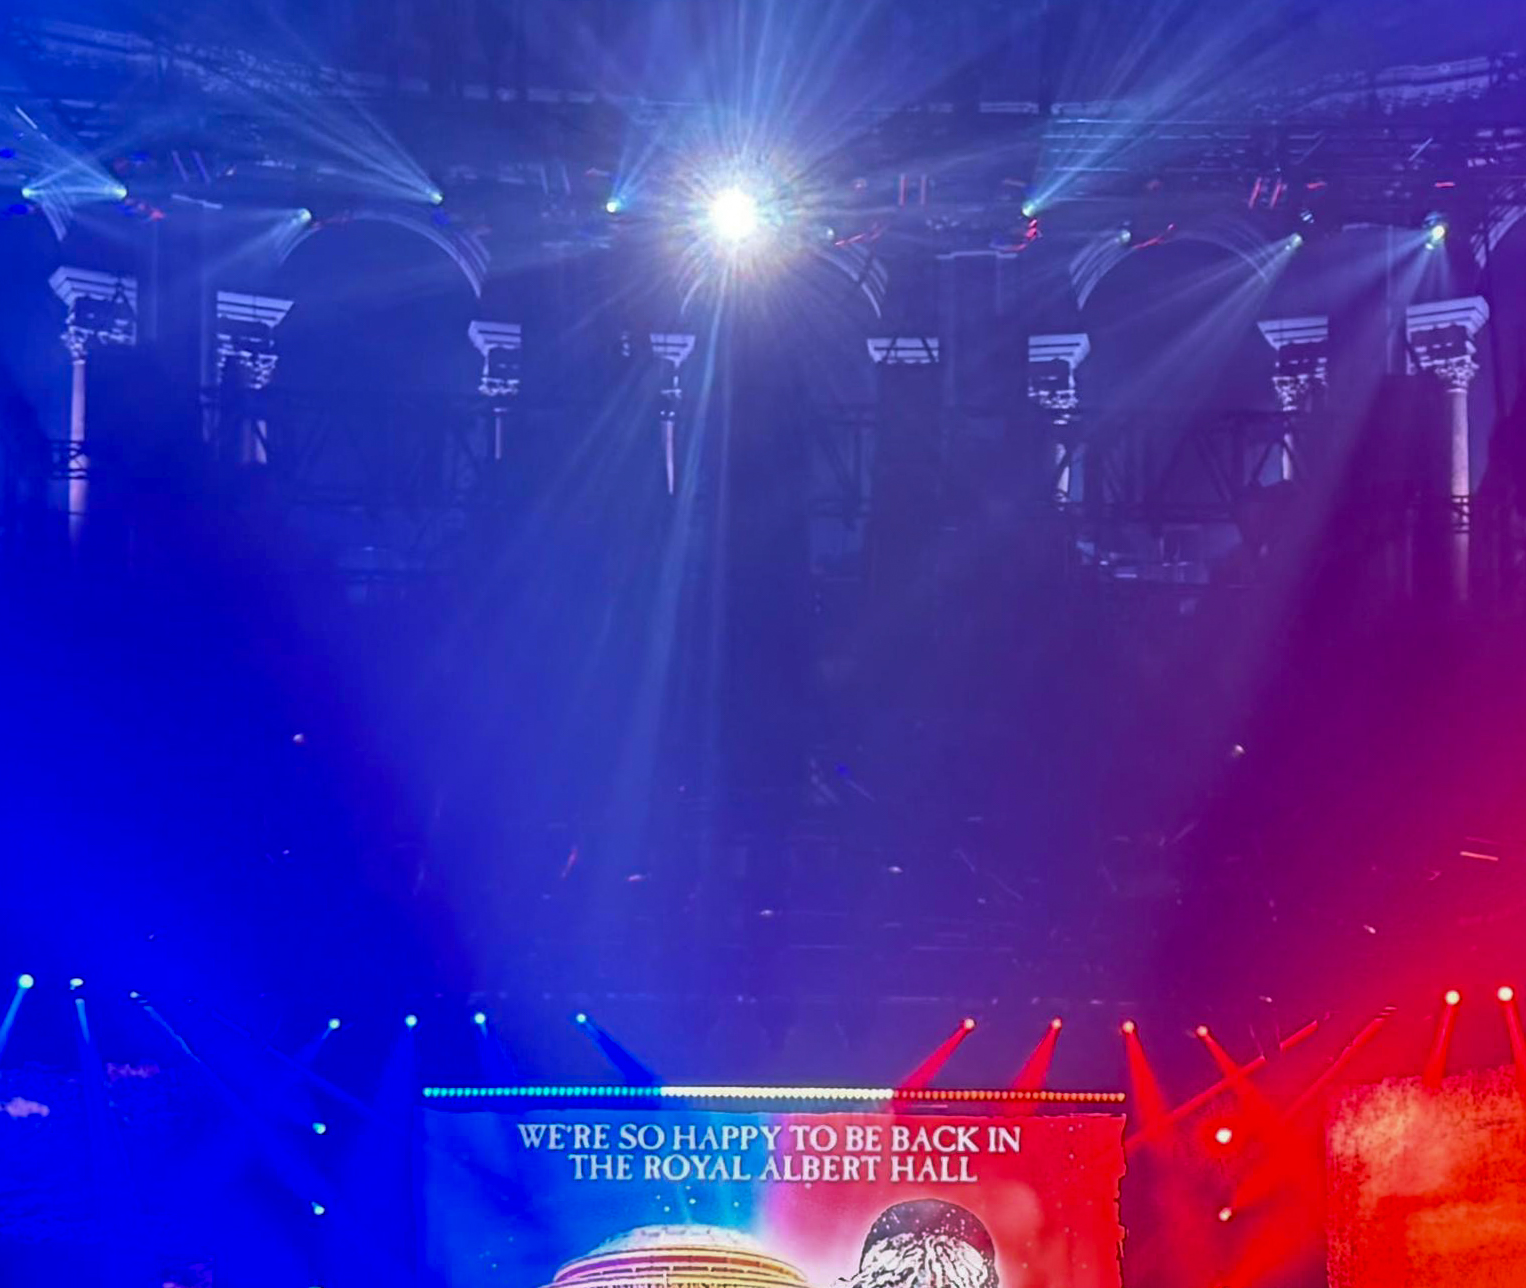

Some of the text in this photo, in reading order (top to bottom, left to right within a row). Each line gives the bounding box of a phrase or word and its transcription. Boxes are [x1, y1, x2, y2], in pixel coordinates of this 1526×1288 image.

[517, 1123, 1022, 1153] WE'RE SO HAPPY TO BE BACK IN
[568, 1154, 979, 1182] THE ROYAL ALBERT HALL
